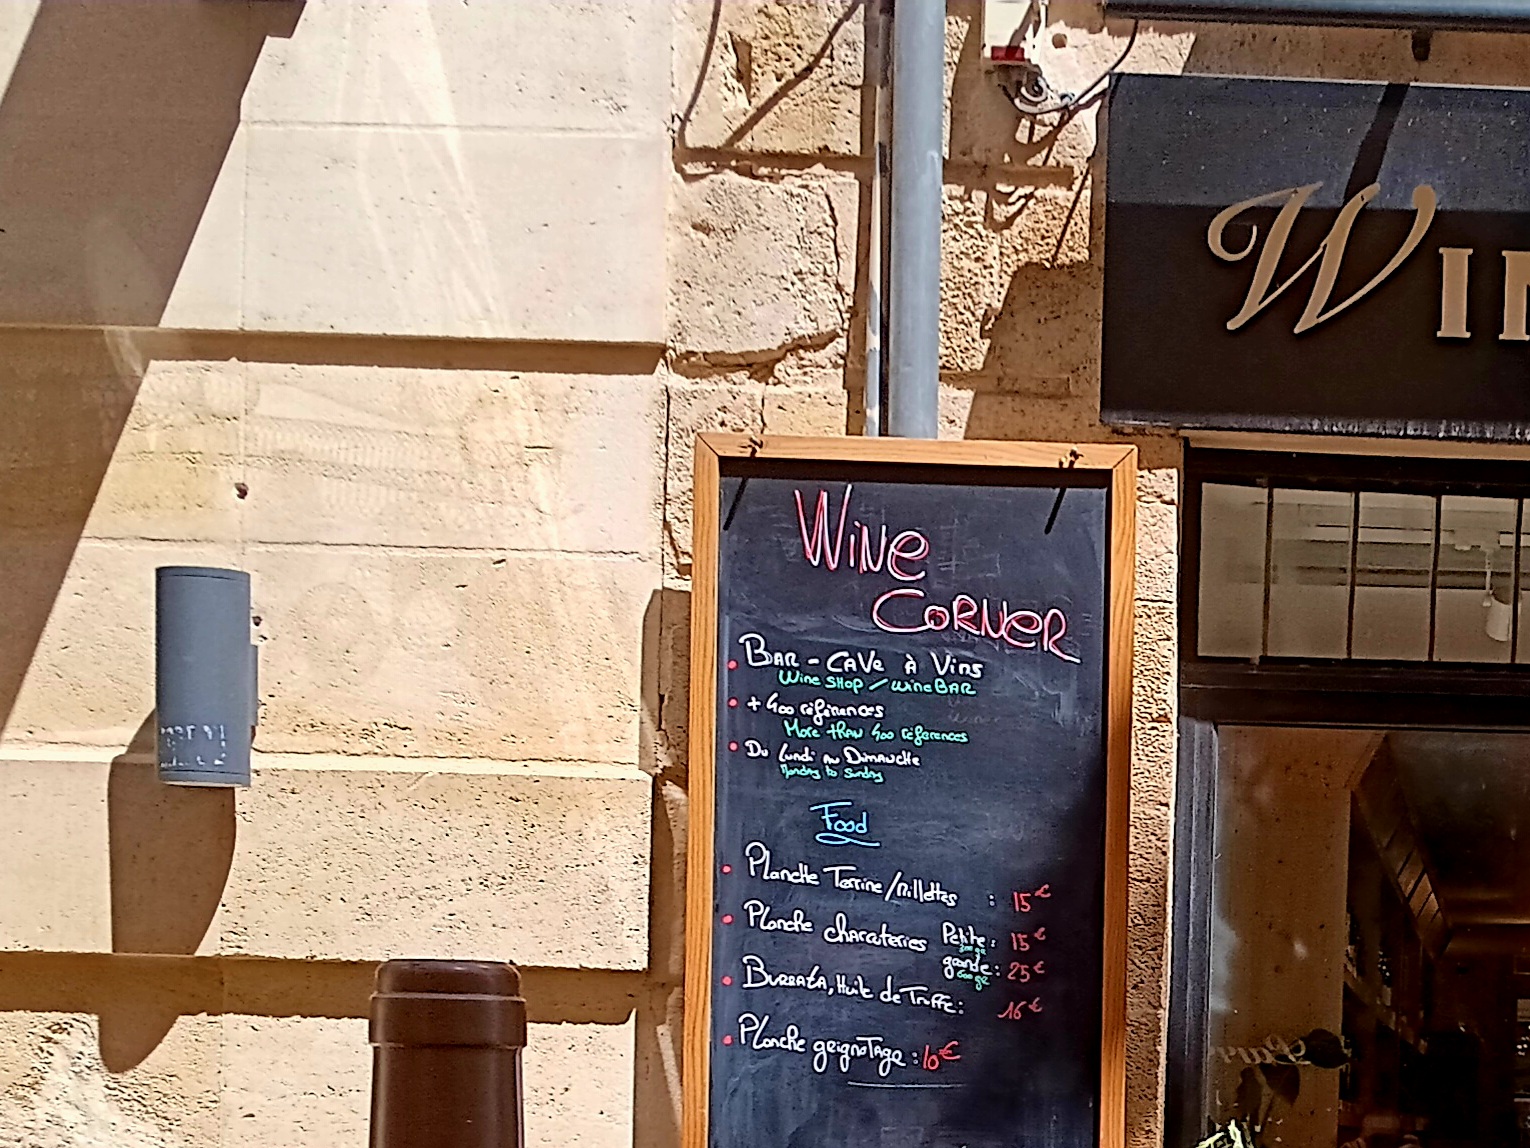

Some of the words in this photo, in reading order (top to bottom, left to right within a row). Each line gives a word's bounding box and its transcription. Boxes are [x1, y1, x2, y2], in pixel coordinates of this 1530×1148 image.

[931, 650, 984, 679] Vins
[783, 716, 821, 739] More
[744, 739, 770, 758] Du
[810, 801, 868, 835] Food
